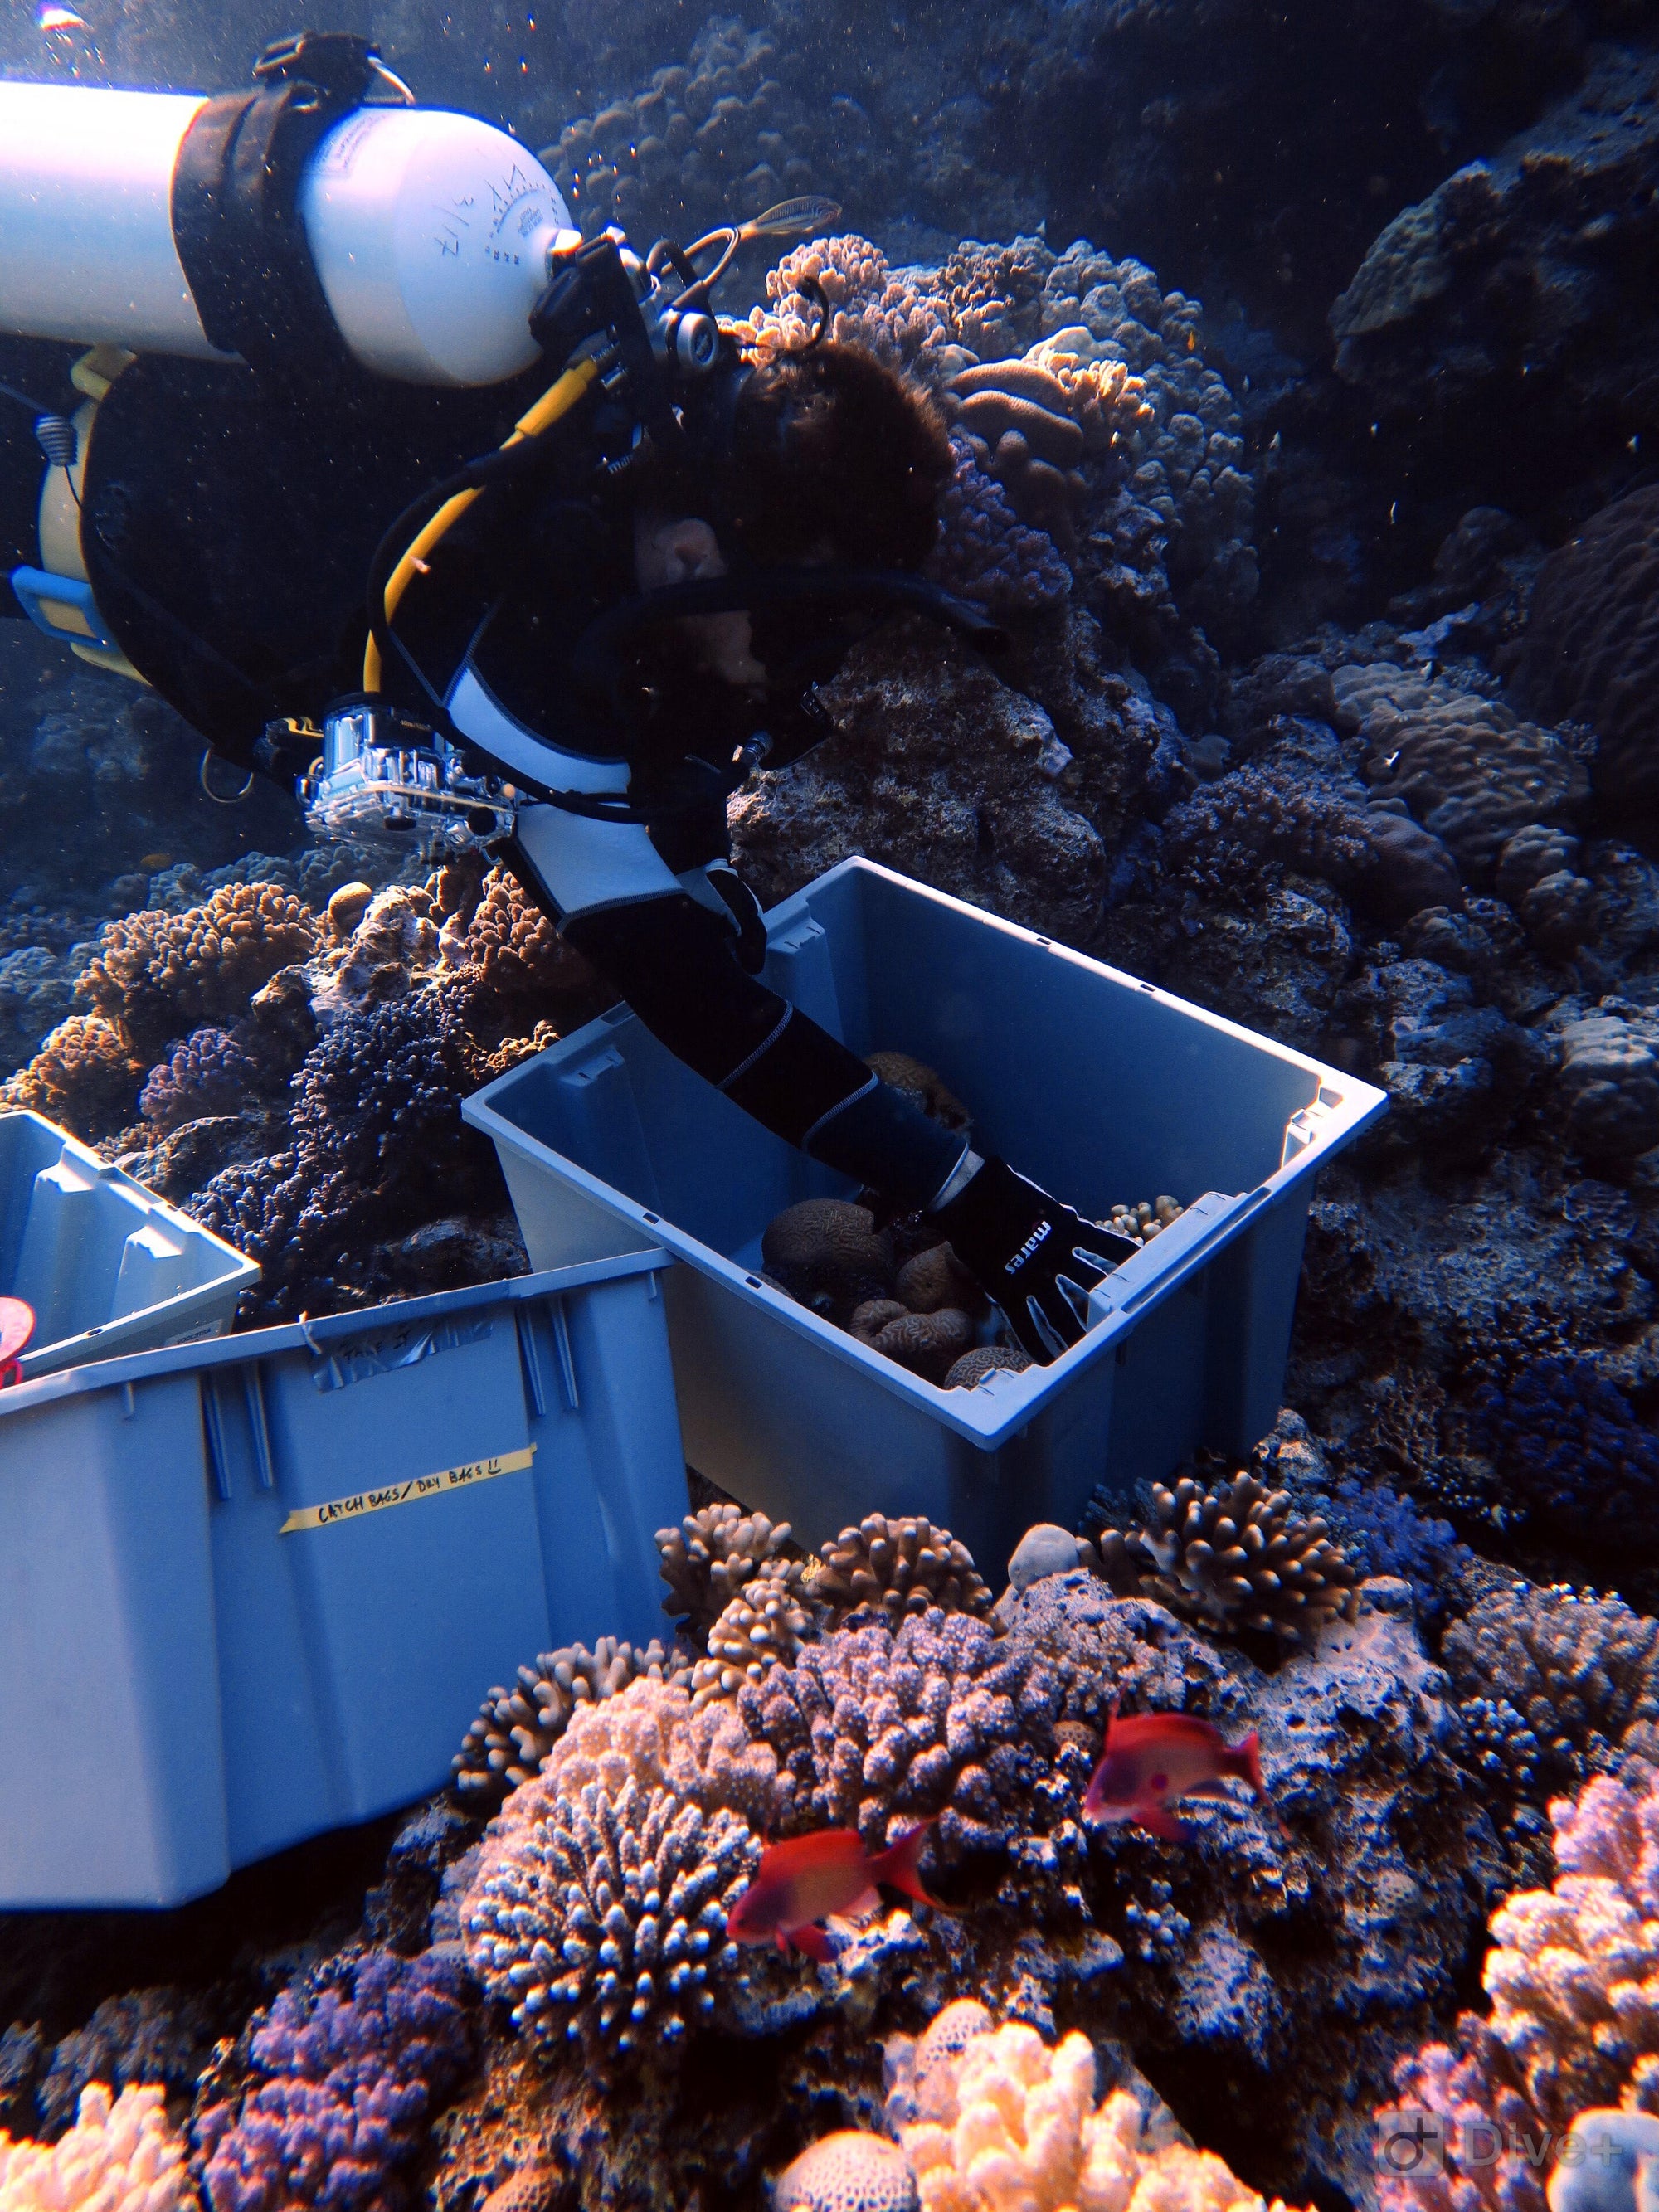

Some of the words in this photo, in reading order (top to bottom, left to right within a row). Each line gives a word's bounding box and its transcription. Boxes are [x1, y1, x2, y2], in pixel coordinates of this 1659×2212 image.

[1004, 1220, 1052, 1275] mares
[318, 1495, 364, 1524] CATCH
[449, 1465, 482, 1485] BAGS
